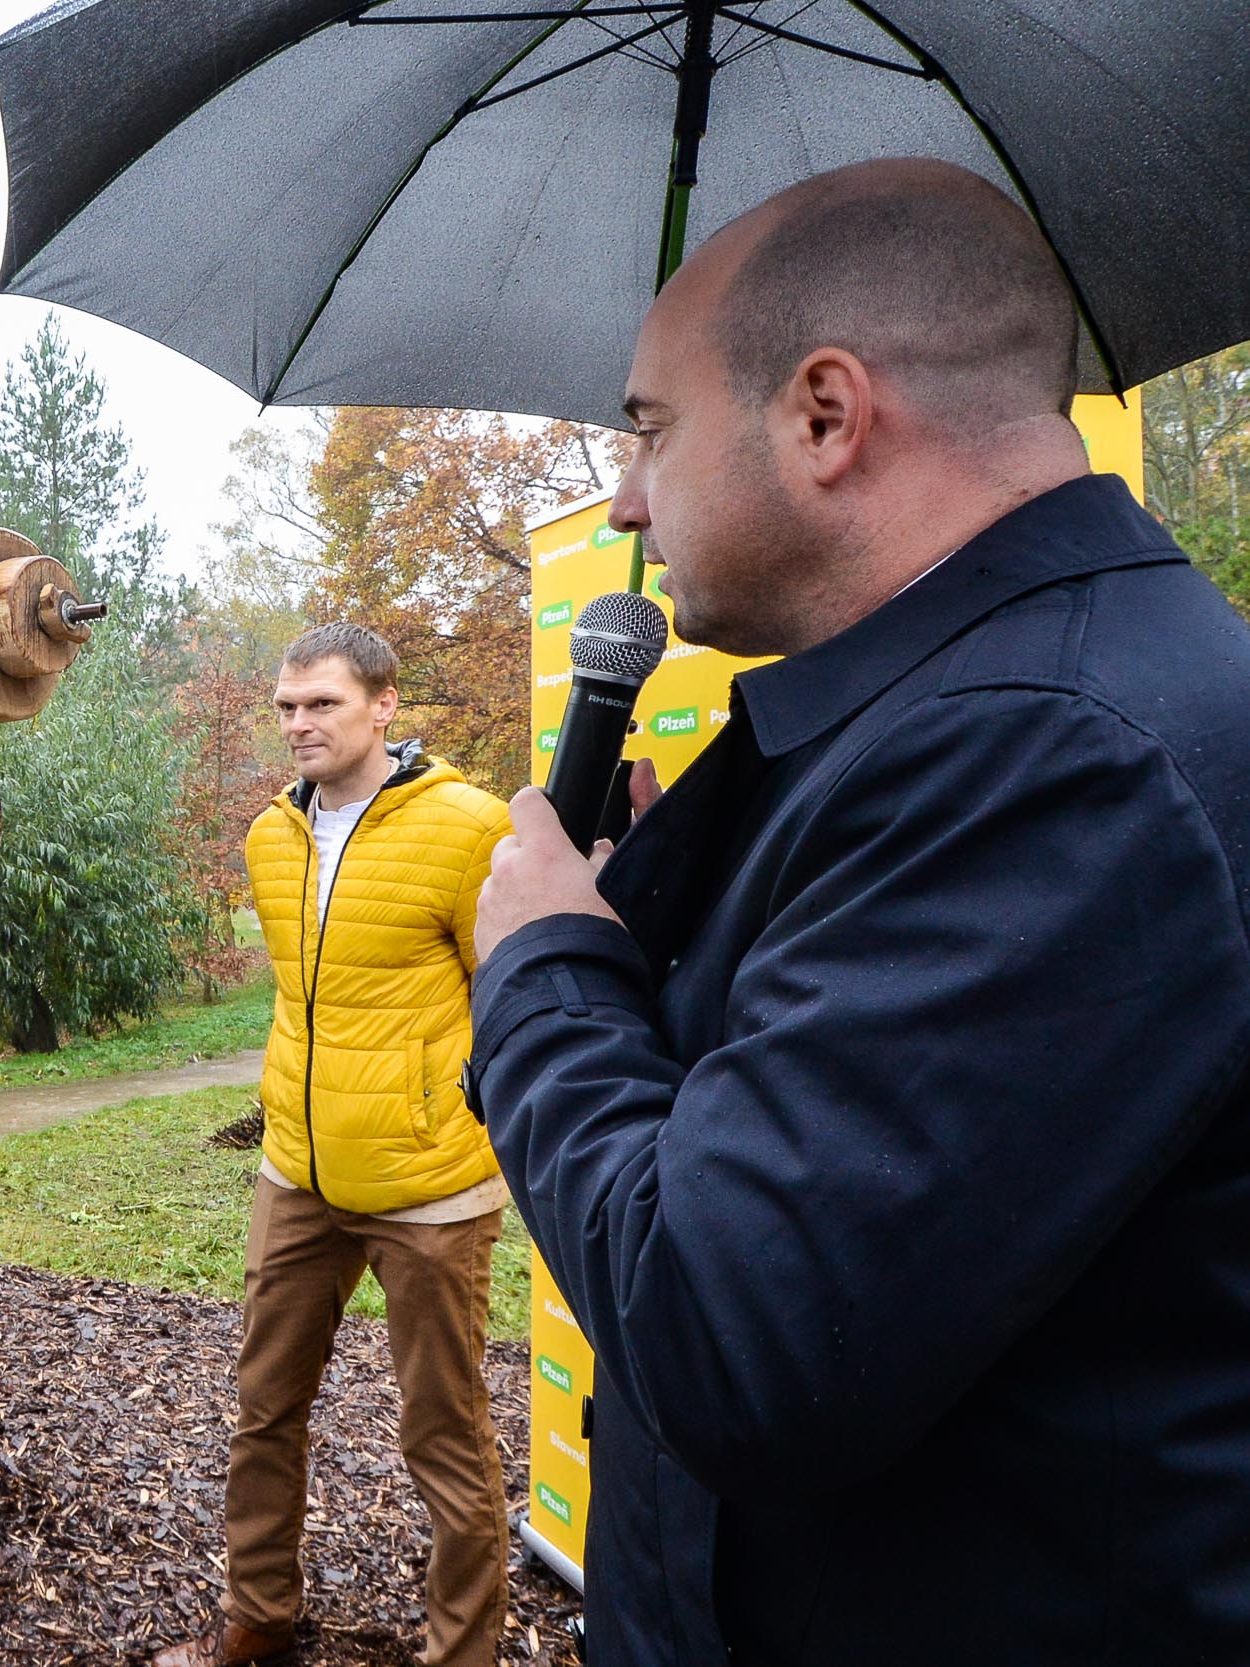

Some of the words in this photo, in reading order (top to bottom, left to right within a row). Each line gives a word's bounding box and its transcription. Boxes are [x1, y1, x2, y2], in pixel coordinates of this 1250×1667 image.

[597, 526, 621, 544] Plz
[541, 605, 570, 625] Plzeň
[536, 667, 574, 688] Bezpeč
[588, 694, 605, 705] RH
[657, 712, 695, 733] Plzeň
[541, 734, 559, 749] Plz
[541, 1359, 570, 1390] Plzeň
[540, 1487, 569, 1521] Plzeň
